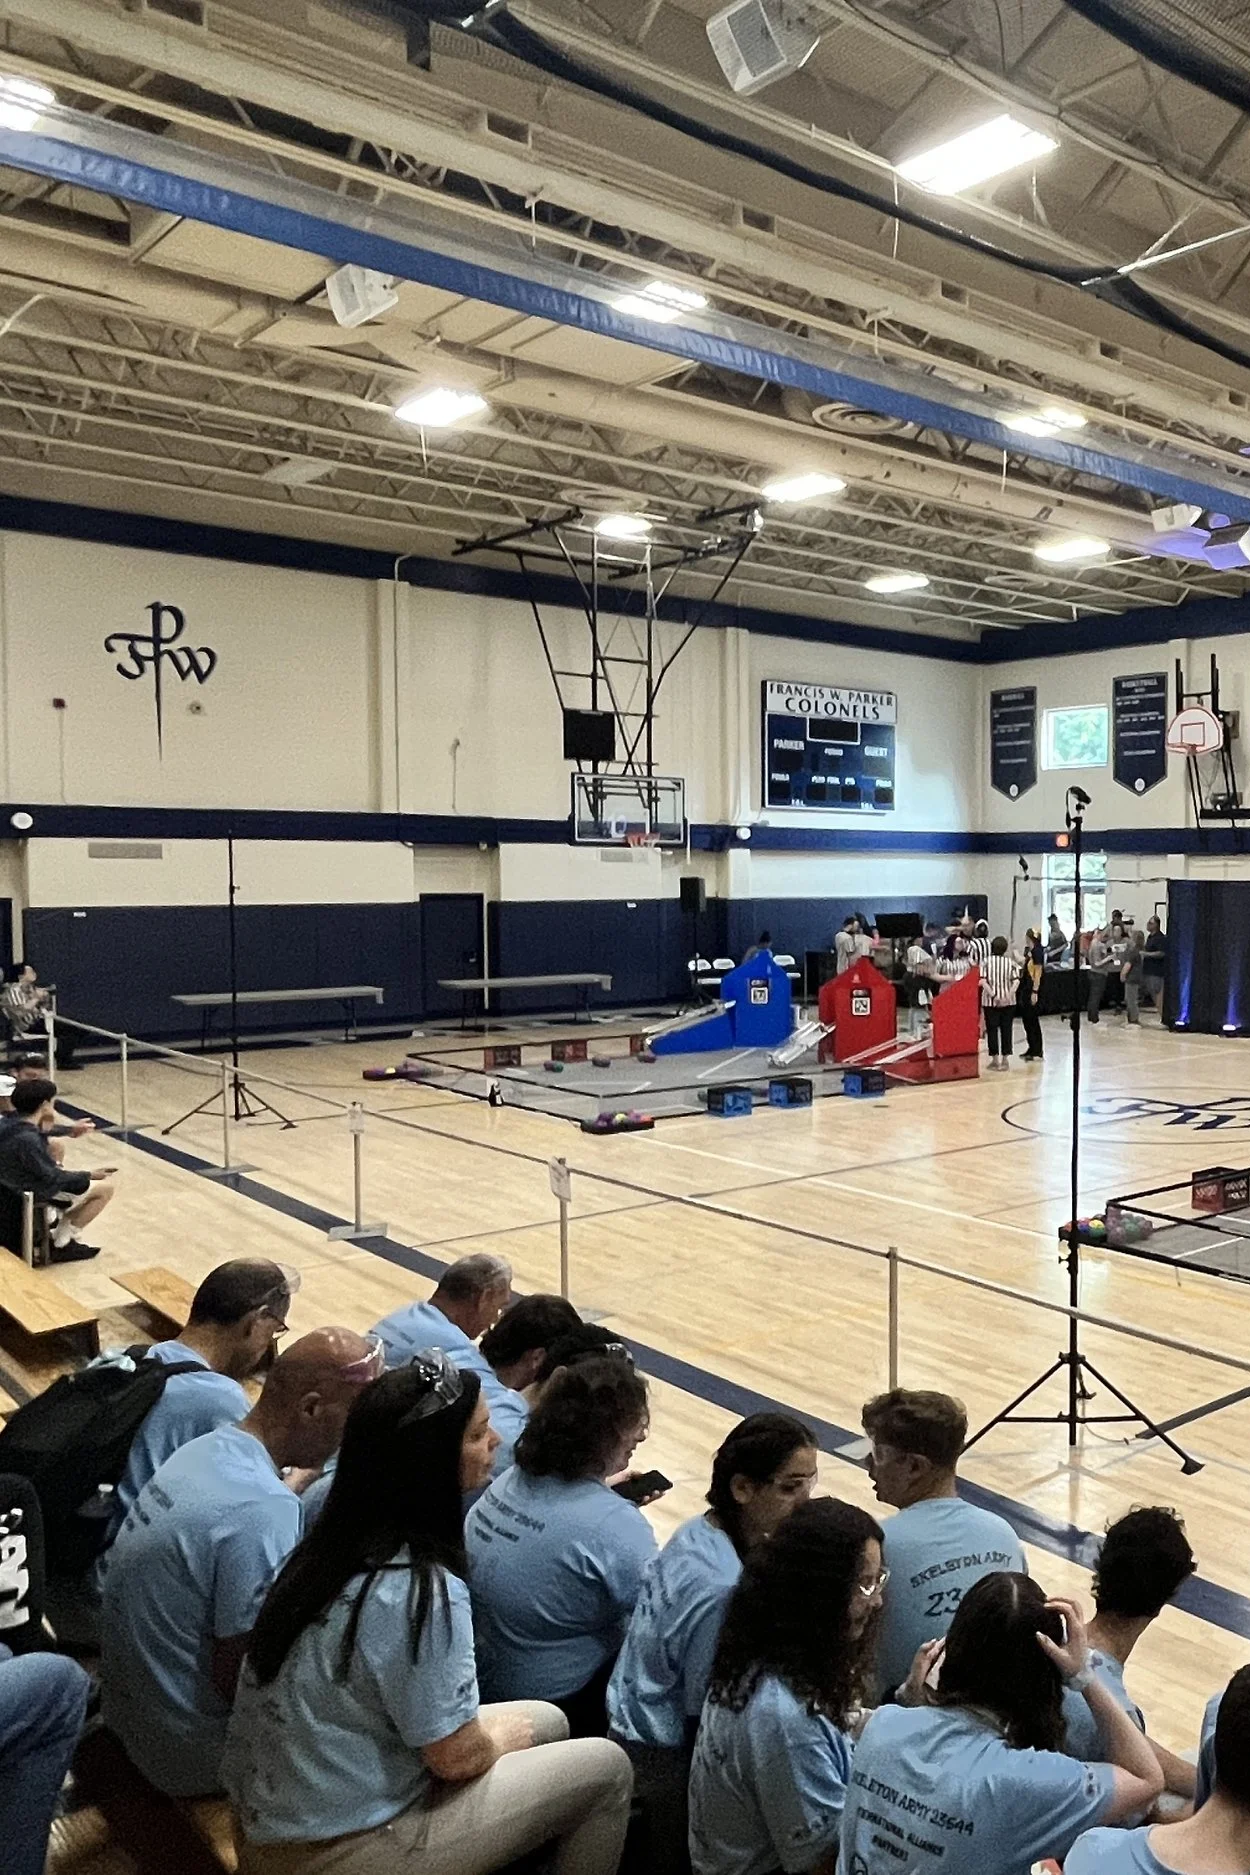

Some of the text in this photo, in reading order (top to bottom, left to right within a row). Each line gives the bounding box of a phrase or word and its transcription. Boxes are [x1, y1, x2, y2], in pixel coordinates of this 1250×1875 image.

[770, 683, 824, 700] FRANCIS
[848, 692, 893, 706] PARKER
[785, 698, 880, 720] COLONELS
[774, 739, 805, 751] PARKER
[909, 1551, 1012, 1589] SKELETON ARMY
[924, 1587, 963, 1617] 23
